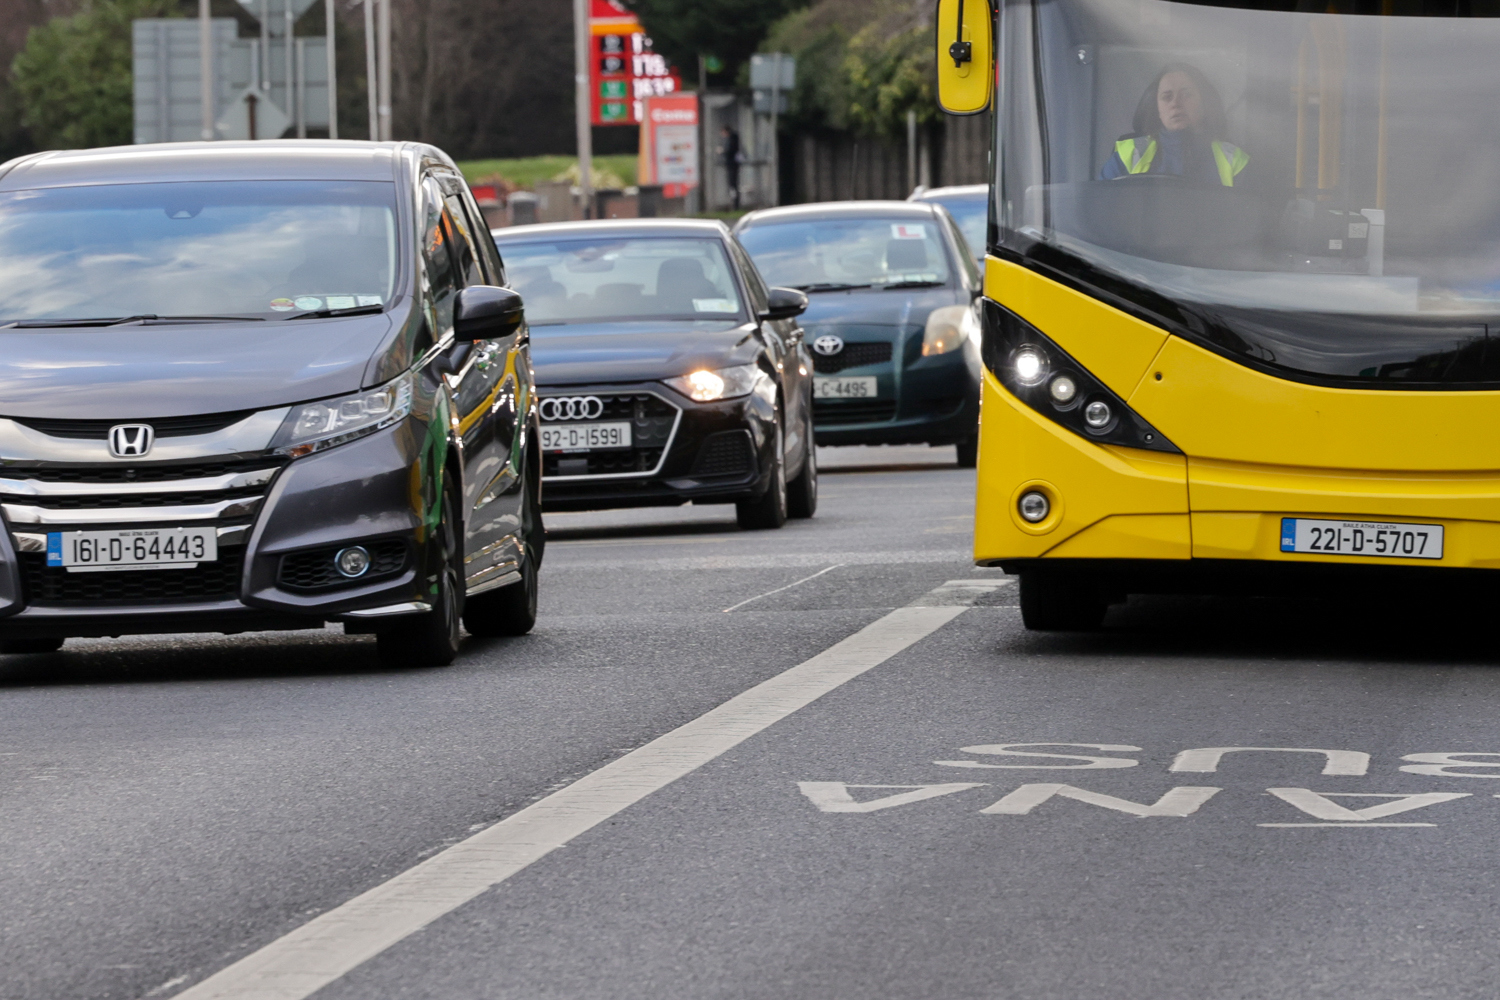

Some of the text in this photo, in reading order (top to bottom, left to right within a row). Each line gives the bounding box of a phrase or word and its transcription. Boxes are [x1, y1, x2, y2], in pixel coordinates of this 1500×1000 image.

[816, 381, 868, 397] -C-4495
[542, 428, 622, 447] 92-D-15991
[73, 535, 205, 563] 161-D-64443
[1282, 537, 1295, 546] IRL
[1310, 528, 1428, 554] 221-D-5707
[48, 552, 62, 561] IRL
